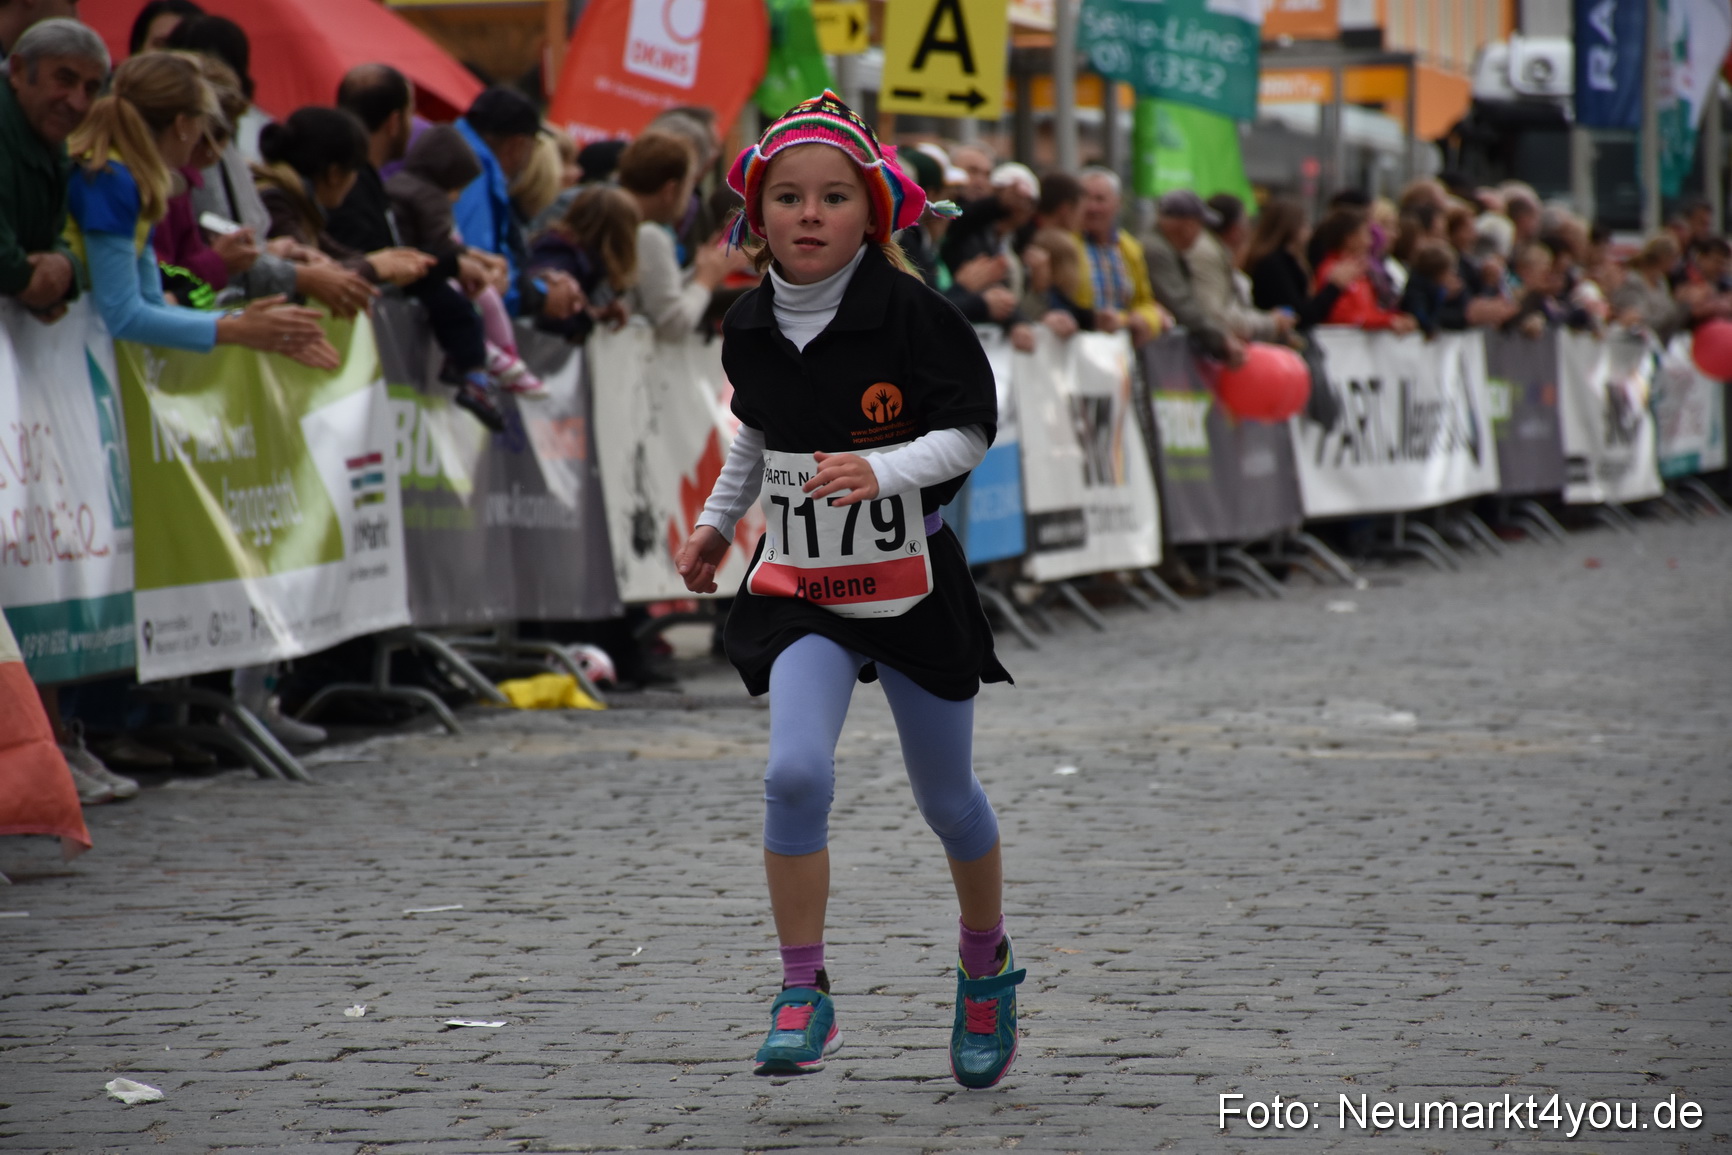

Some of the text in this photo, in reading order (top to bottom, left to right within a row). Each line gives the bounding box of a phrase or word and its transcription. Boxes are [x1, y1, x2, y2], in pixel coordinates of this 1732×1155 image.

[911, 0, 978, 75] A
[764, 467, 795, 486] PARTL
[770, 495, 906, 559] 7179
[767, 549, 775, 561] 3
[909, 542, 917, 553] K
[794, 575, 877, 600] Helene
